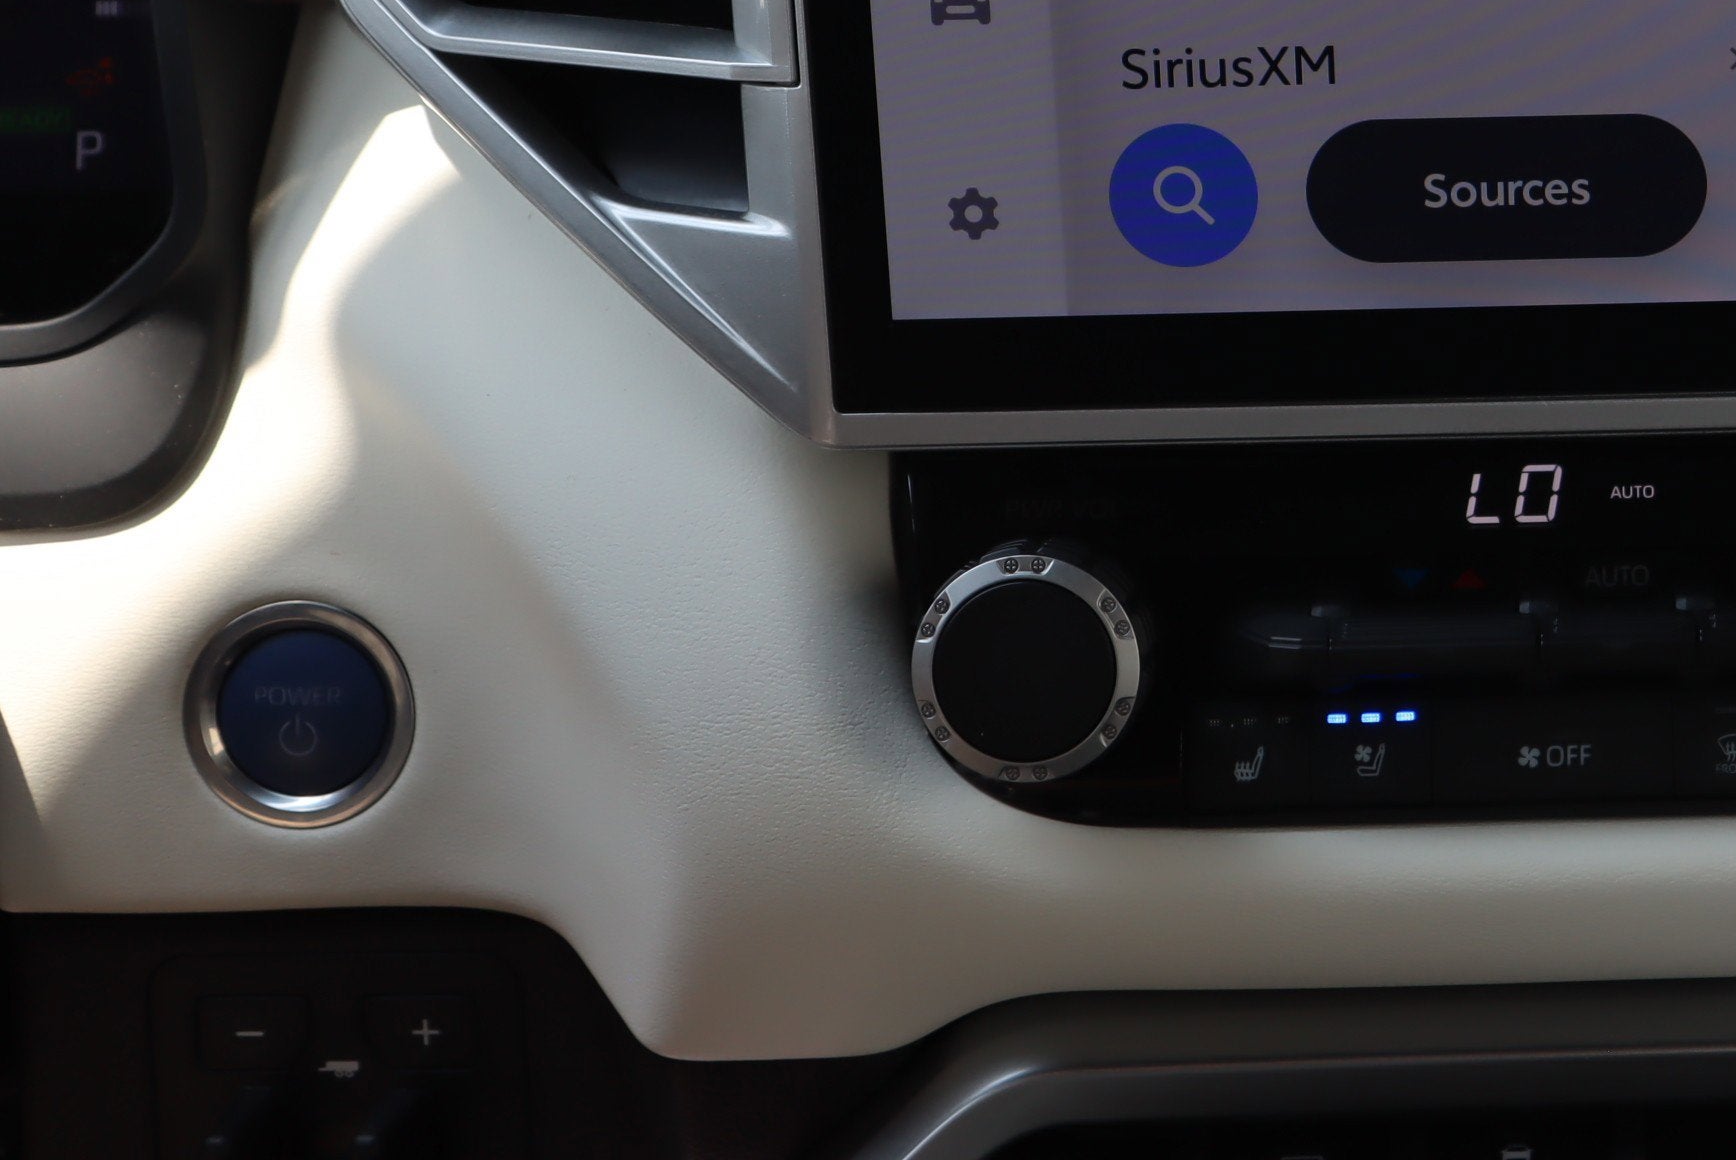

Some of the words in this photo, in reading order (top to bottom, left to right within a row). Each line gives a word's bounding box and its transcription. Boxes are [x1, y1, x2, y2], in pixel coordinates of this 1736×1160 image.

[1121, 45, 1336, 90] SiriusXM
[75, 130, 105, 171] P
[1423, 173, 1591, 209] Sources
[1610, 484, 1655, 500] AUTO
[1584, 563, 1650, 588] AUTO
[254, 686, 341, 706] POWER
[1546, 744, 1592, 768] OFF
